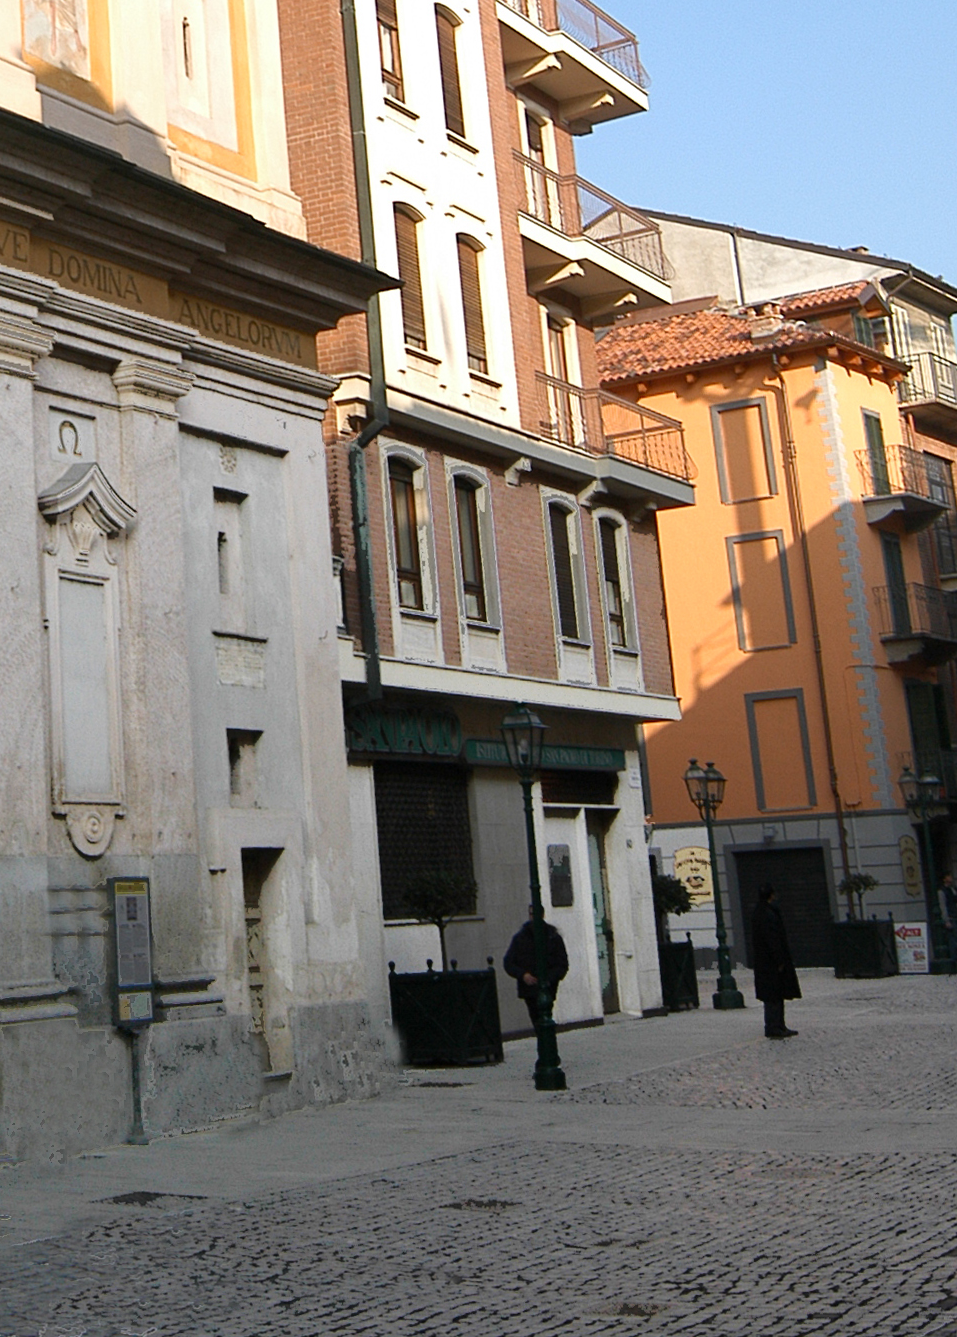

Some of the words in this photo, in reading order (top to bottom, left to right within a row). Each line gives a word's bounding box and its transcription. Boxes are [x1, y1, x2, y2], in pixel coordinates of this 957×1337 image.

[48, 248, 142, 304] DOMINA
[178, 298, 302, 360] ANGELORVM
[57, 419, 82, 457] Ω
